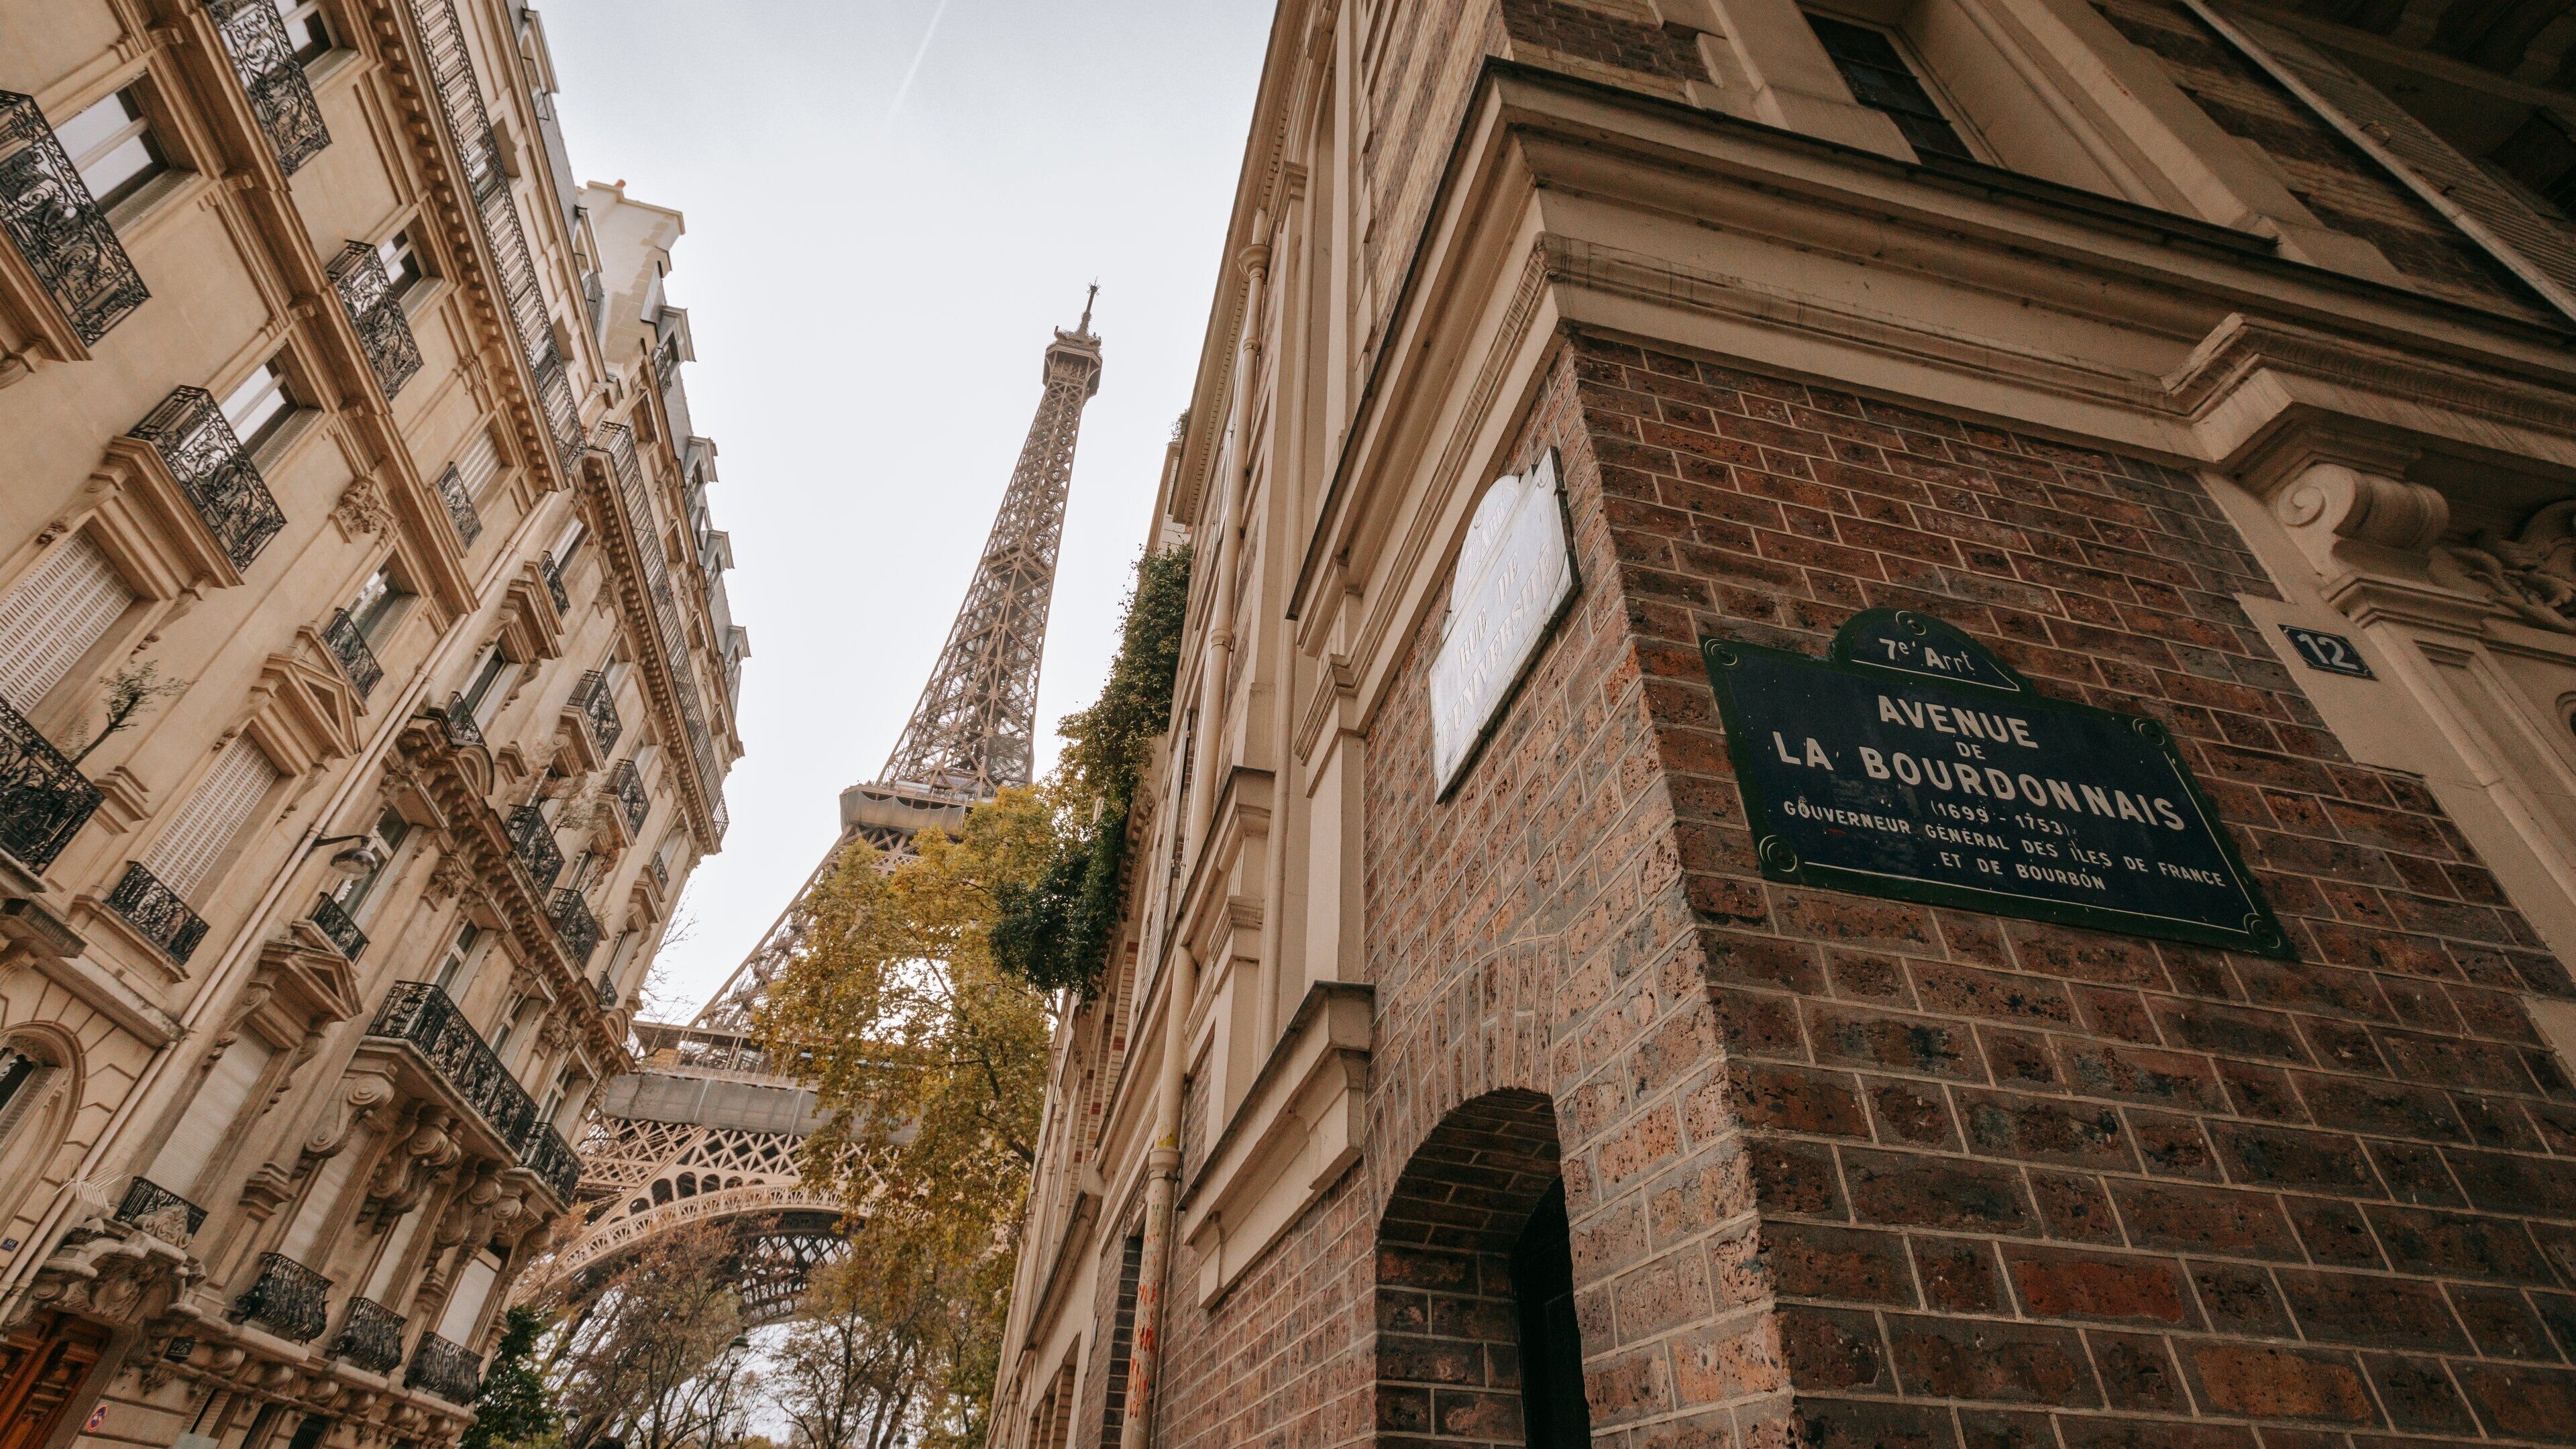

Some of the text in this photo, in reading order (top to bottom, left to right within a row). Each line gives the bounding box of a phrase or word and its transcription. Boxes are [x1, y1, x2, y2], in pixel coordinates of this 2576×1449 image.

[1459, 549, 1519, 672] RUE DE
[2297, 633, 2359, 670] 12
[1878, 694, 2039, 749] AVENUE
[1957, 741, 1986, 760] DE
[1773, 731, 2185, 830] LA BOURDONNAIS
[1931, 800, 1990, 823] (1699
[2015, 814, 2070, 837] 1753)
[1783, 800, 1911, 834] GOUVERNEUR
[2021, 839, 2058, 857] DES
[2123, 855, 2149, 872] DE
[2157, 861, 2226, 887] FRANCE
[1939, 851, 2106, 890] ET DE BOURBON
